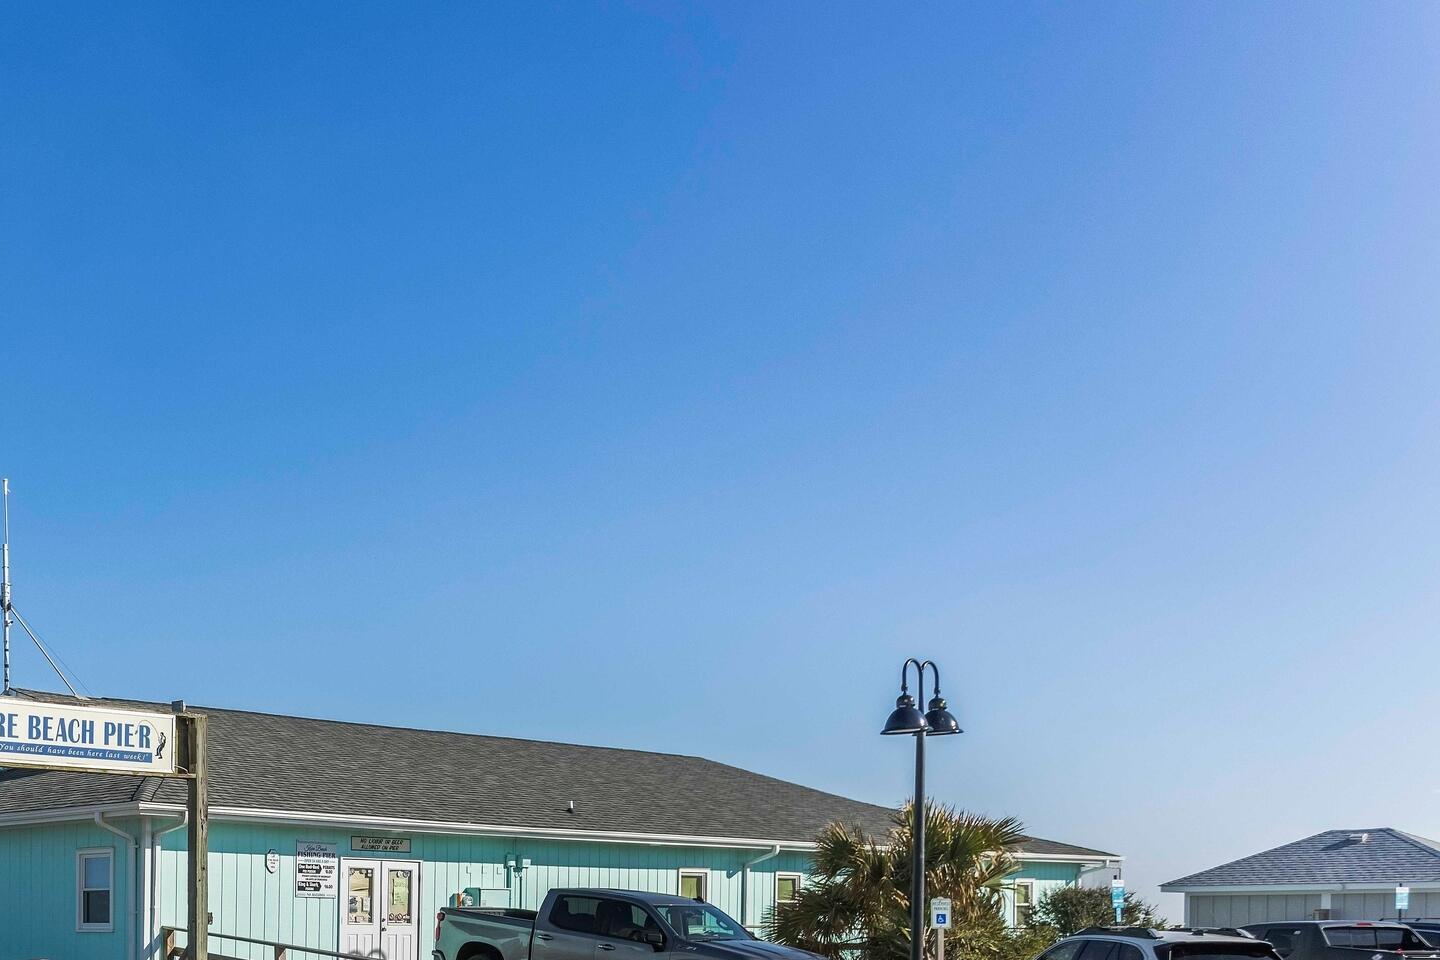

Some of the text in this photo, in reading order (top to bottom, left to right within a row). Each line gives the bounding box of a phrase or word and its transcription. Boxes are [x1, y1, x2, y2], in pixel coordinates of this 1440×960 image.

[28, 714, 95, 745] BEACH
[103, 721, 151, 749] PIER
[16, 744, 44, 753] should
[47, 746, 65, 755] have
[67, 748, 84, 756] been
[86, 749, 103, 757] here
[105, 750, 120, 759] last
